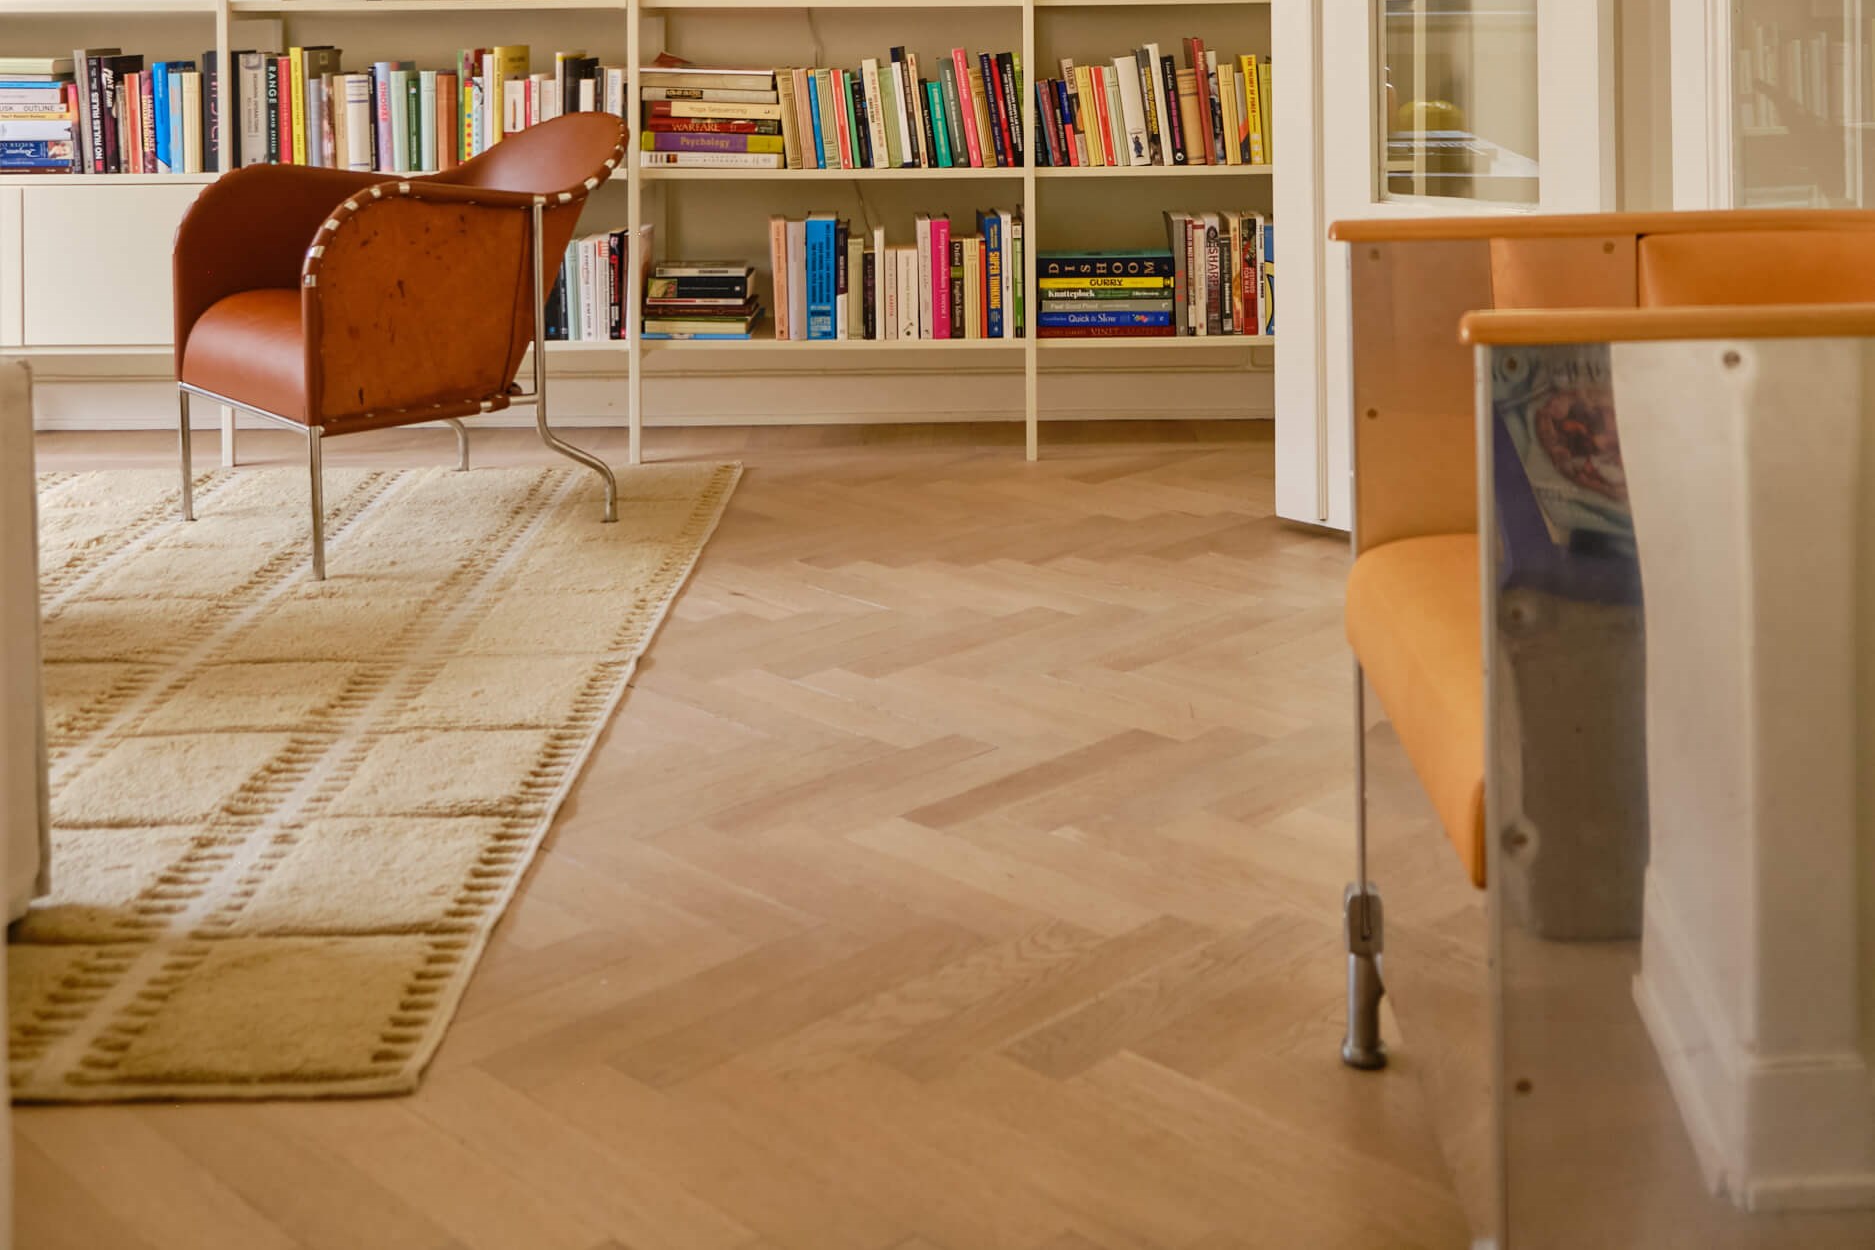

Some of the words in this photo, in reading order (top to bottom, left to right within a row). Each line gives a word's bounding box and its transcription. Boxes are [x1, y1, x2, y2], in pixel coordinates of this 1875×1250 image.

[269, 66, 278, 103] RANGE
[91, 92, 100, 118] RULES
[671, 123, 721, 132] WARFARE
[95, 148, 103, 159] NO
[680, 136, 730, 148] Psychology
[954, 243, 962, 266] Oxford
[990, 251, 1000, 274] SUPER
[1207, 248, 1219, 286] SHARP
[953, 281, 962, 304] English
[990, 276, 1001, 309] THINKING
[1089, 278, 1124, 287] CURRY
[1068, 313, 1090, 323] Quick
[1097, 312, 1118, 323] Slow
